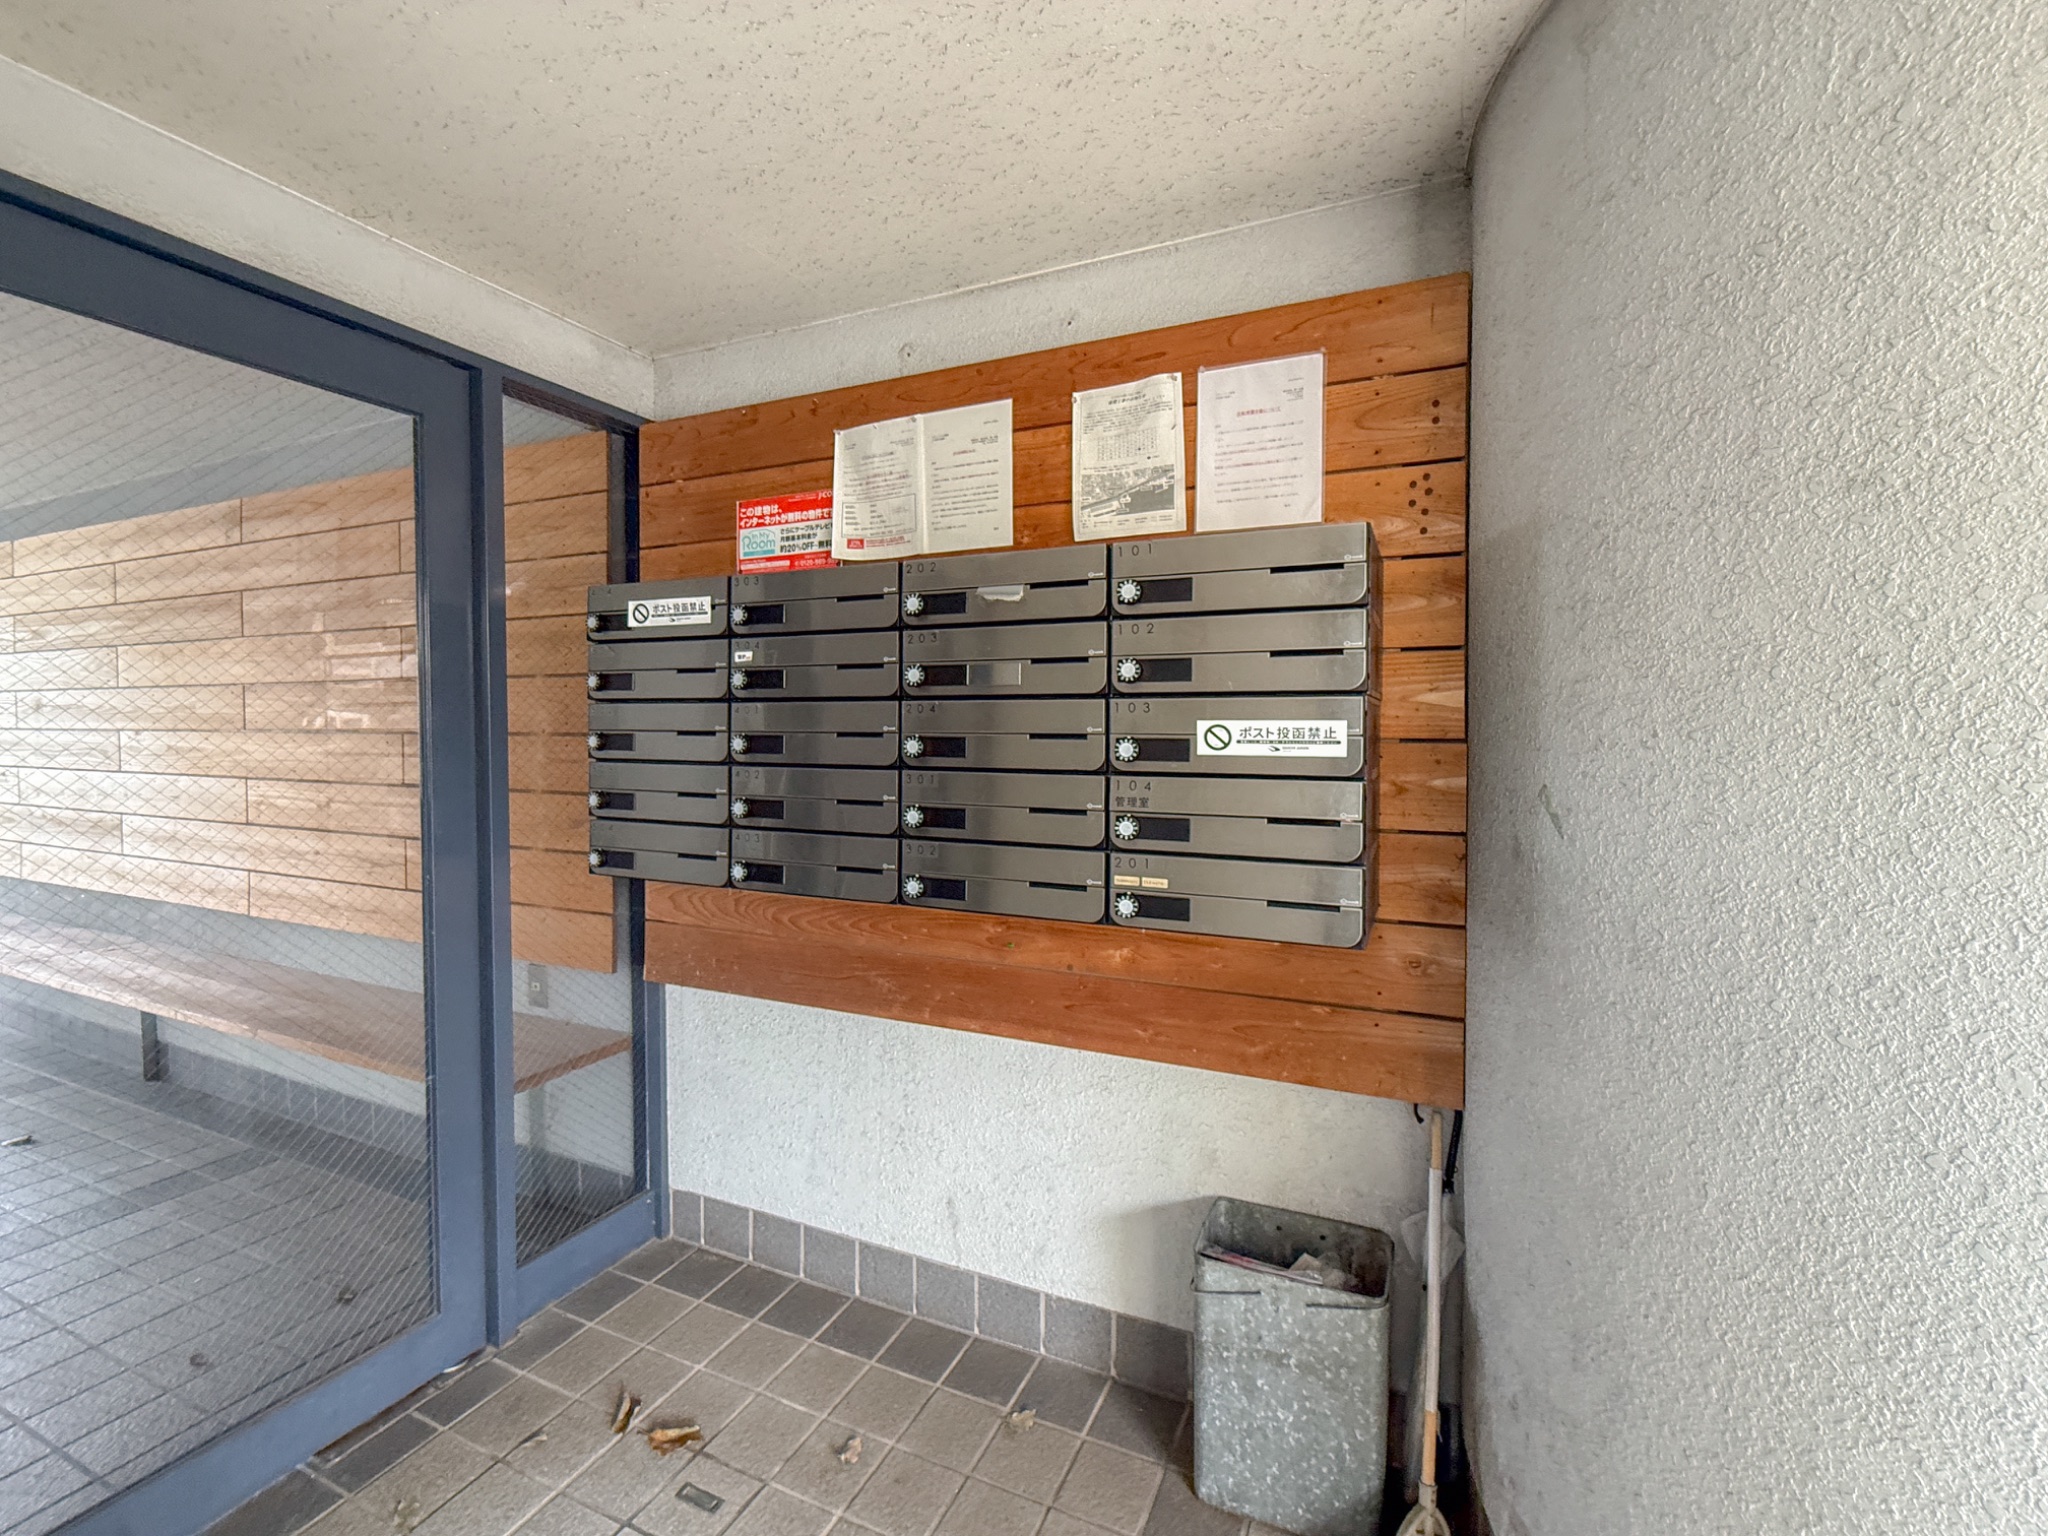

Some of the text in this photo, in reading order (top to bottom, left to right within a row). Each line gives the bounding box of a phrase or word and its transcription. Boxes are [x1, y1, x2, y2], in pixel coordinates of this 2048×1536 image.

[740, 508, 833, 528] インターネットが無料の物件で
[780, 522, 833, 535] さらにケーブルテレビ
[742, 535, 776, 551] Room
[1118, 543, 1152, 557] 101
[906, 562, 937, 574] 202
[734, 576, 760, 587] 303
[652, 602, 706, 614] ポスト投函禁止
[1118, 624, 1154, 635] 102
[907, 633, 938, 645] 203
[906, 704, 937, 714] 204
[1115, 702, 1151, 714] 103
[1239, 726, 1337, 740] ポスト投函禁止
[906, 774, 935, 784] 301
[1116, 780, 1151, 792] 104
[1115, 796, 1150, 808] 管理室
[906, 844, 937, 854] 302
[1115, 857, 1149, 869] 201
